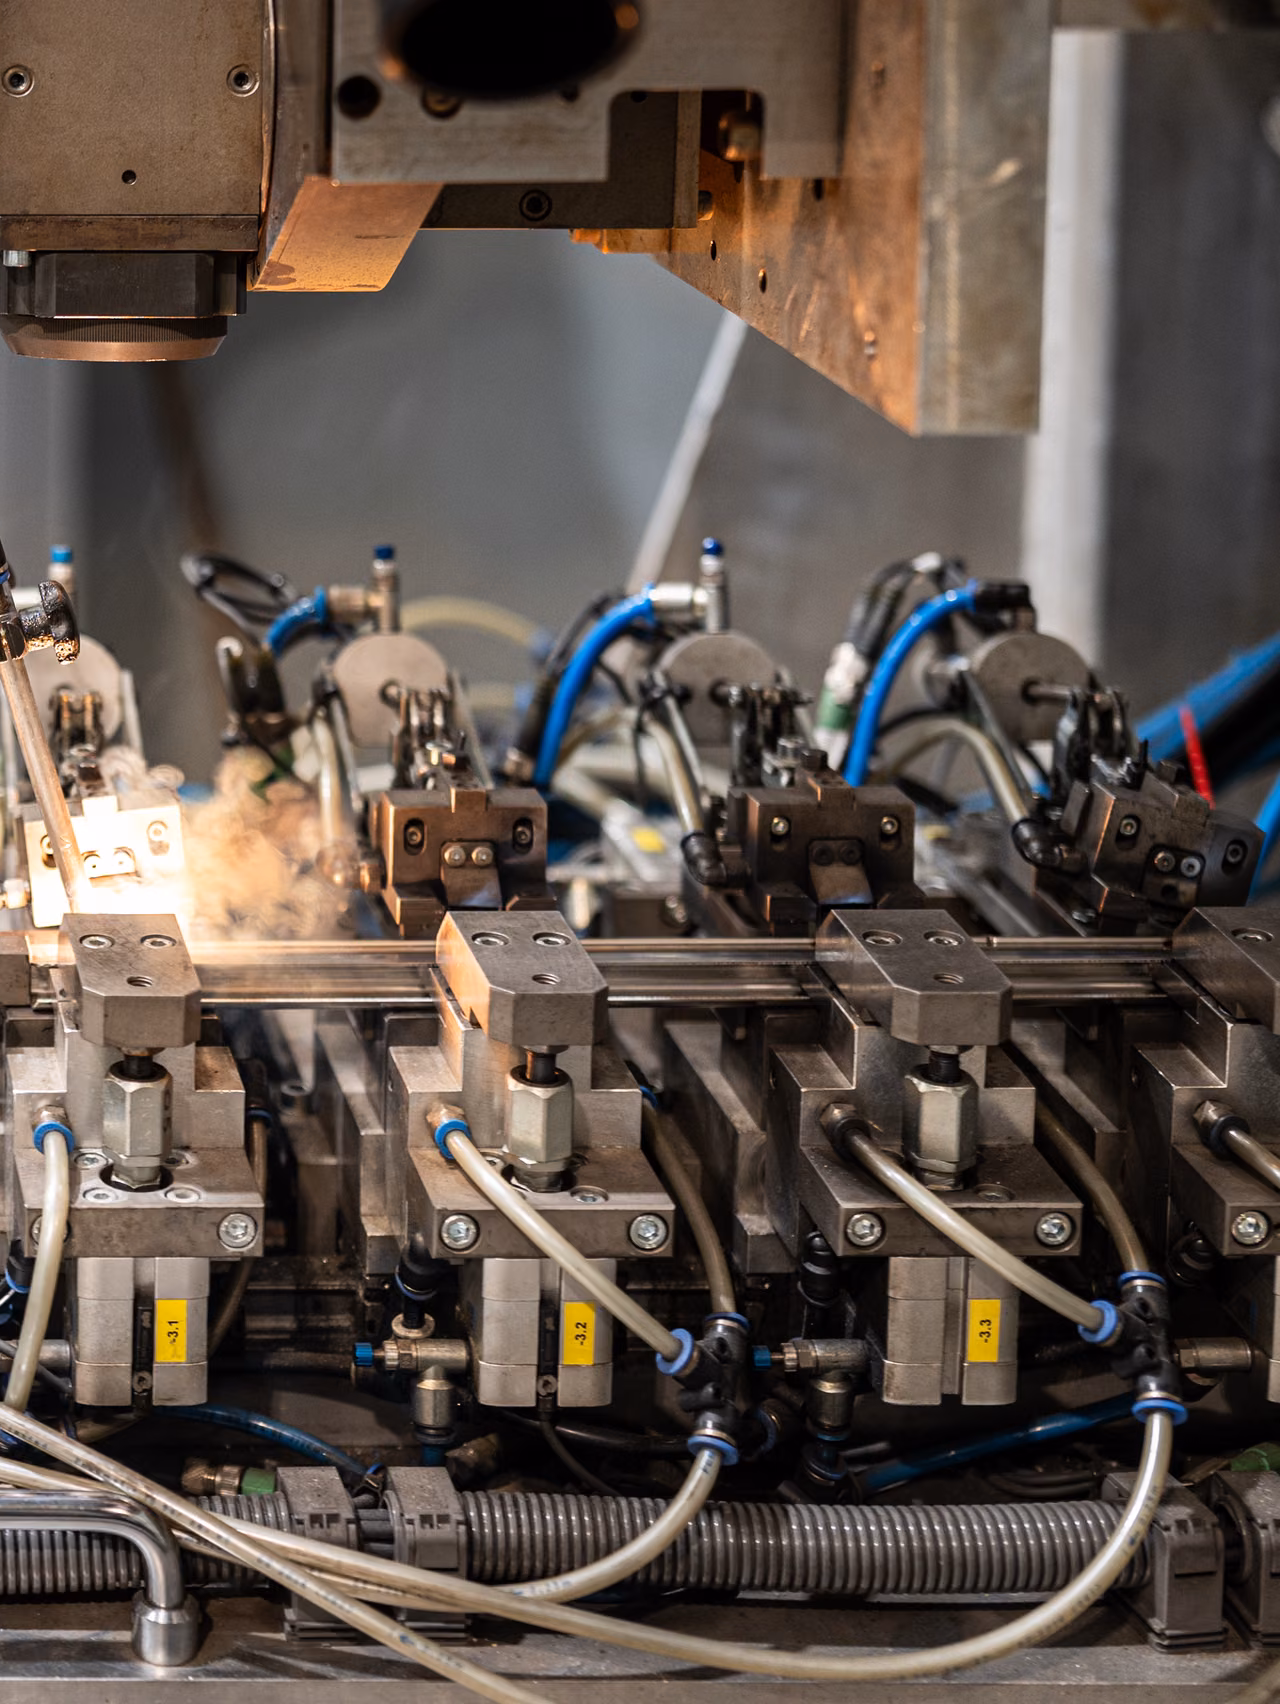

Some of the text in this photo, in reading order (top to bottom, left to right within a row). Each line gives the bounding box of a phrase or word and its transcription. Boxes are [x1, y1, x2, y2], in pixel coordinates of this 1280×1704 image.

[167, 1320, 180, 1344] -3.1
[574, 1321, 588, 1347] -3.2
[978, 1318, 993, 1344] -3.3
